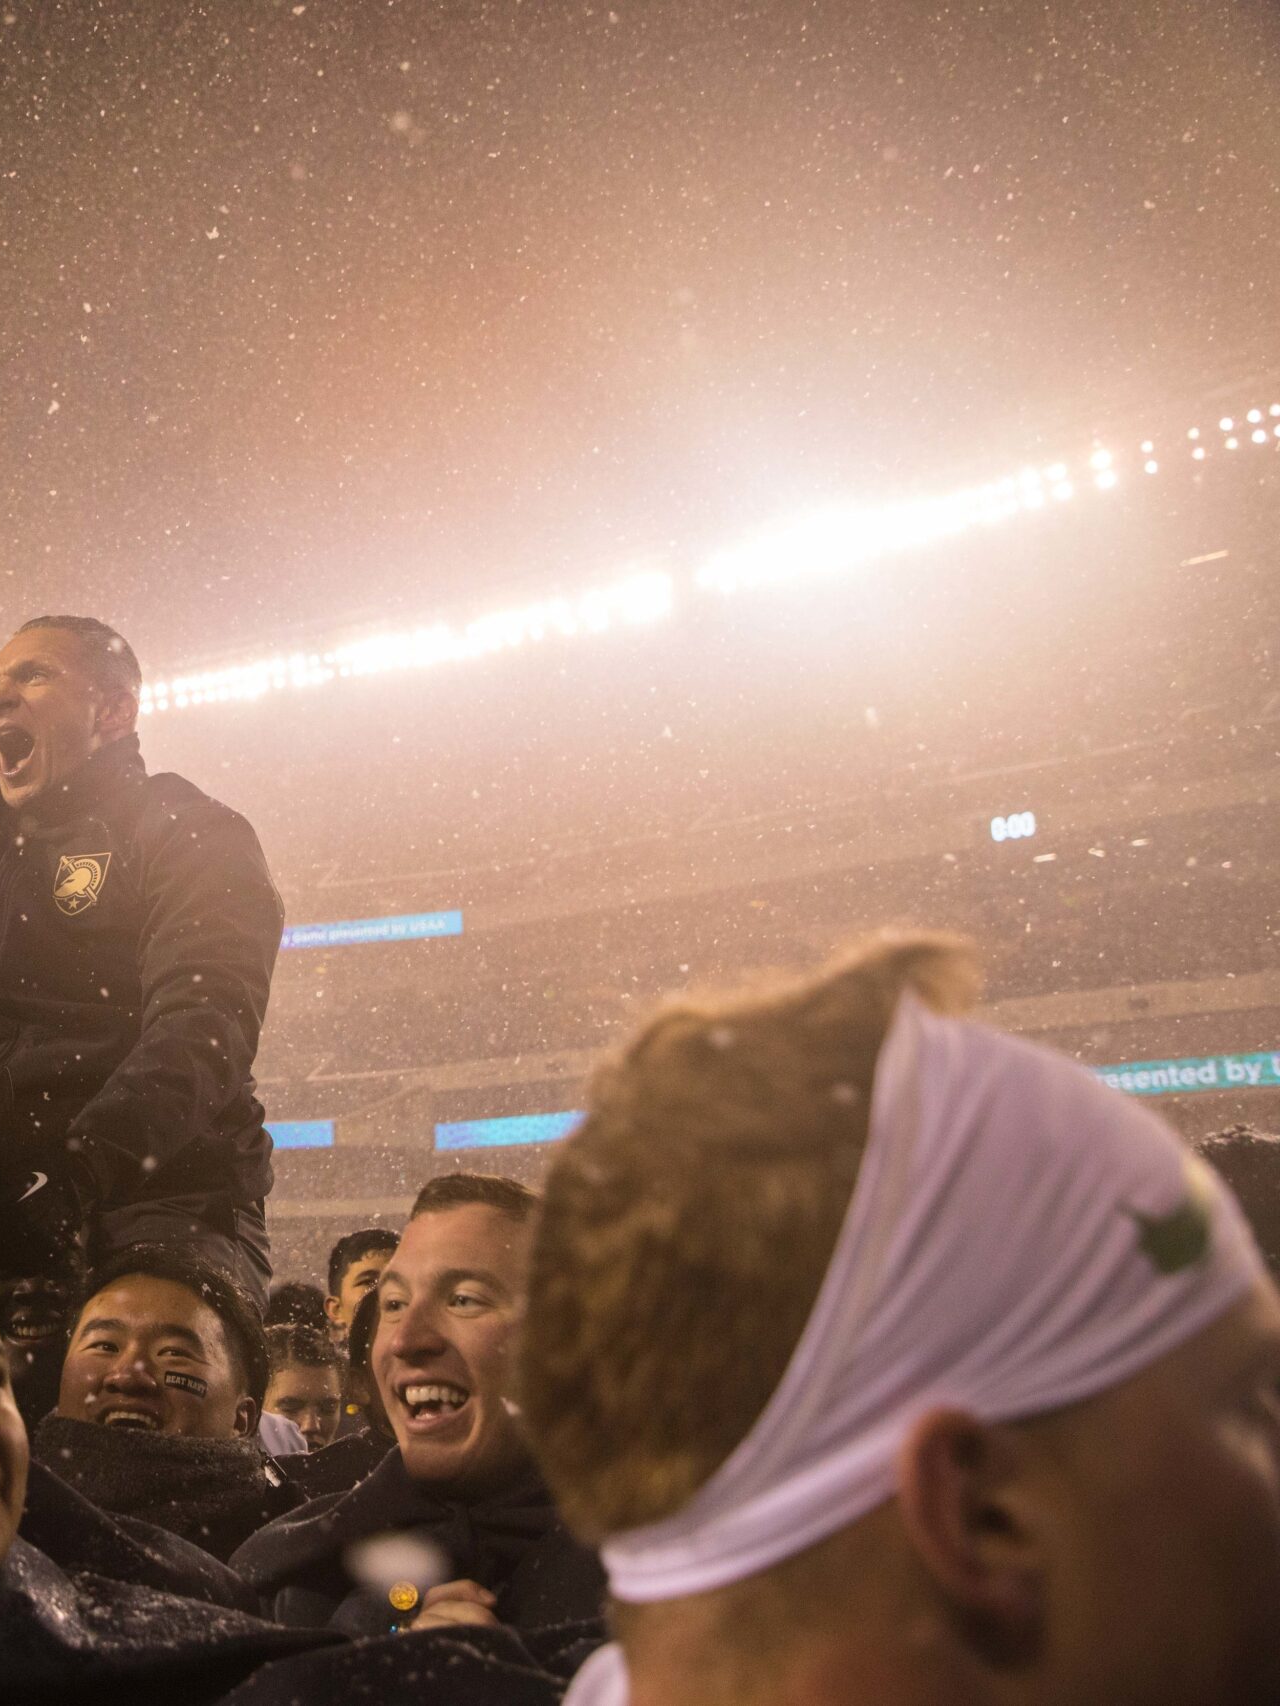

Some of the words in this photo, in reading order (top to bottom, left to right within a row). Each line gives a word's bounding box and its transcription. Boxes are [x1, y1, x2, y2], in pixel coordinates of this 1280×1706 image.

[1101, 1060, 1217, 1090] esented
[1225, 1057, 1261, 1084] by
[165, 1374, 187, 1385] BEAT
